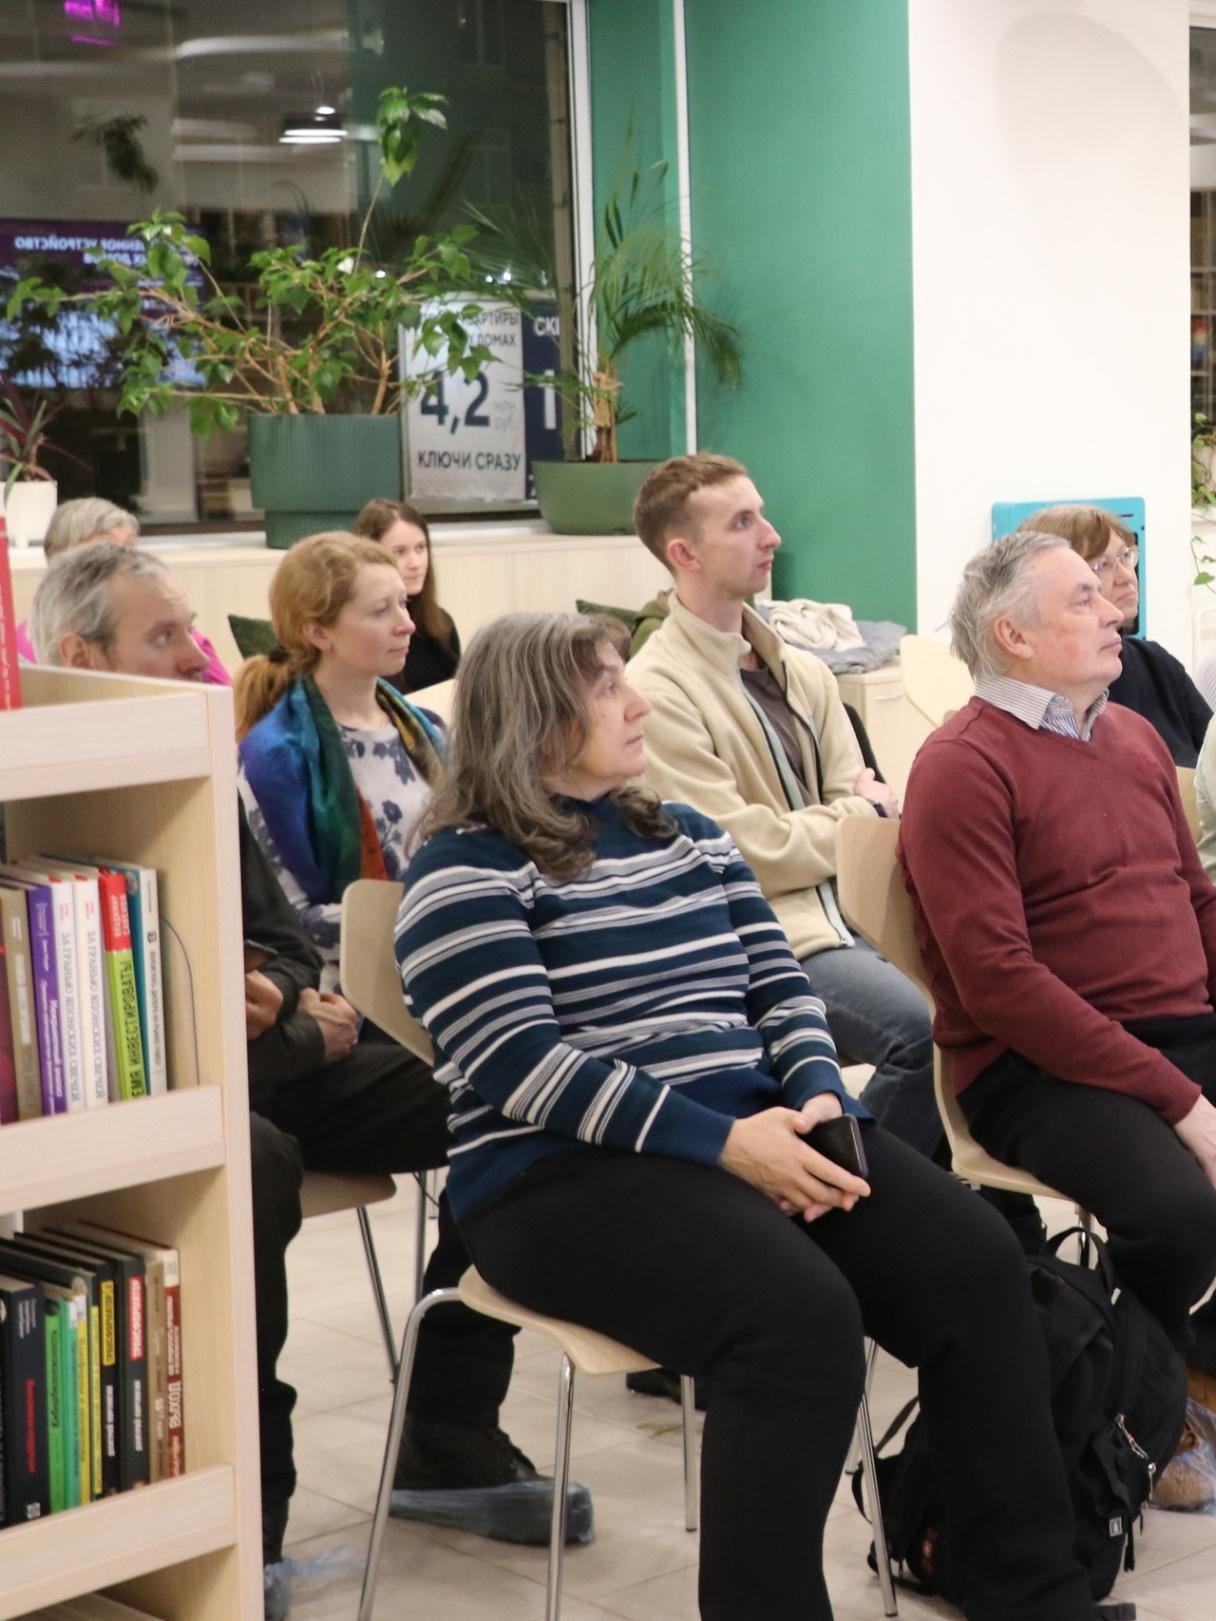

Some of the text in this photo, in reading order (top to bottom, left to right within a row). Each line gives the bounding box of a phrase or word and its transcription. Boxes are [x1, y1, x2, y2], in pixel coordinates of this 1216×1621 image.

[477, 333, 517, 347] ДОМАХ
[420, 370, 491, 435] 4,2
[418, 451, 522, 471] КЛЮЧИ СРАЗУ
[129, 1071, 145, 1097] ЕМЯ
[168, 1381, 182, 1429] ВЫХОД
